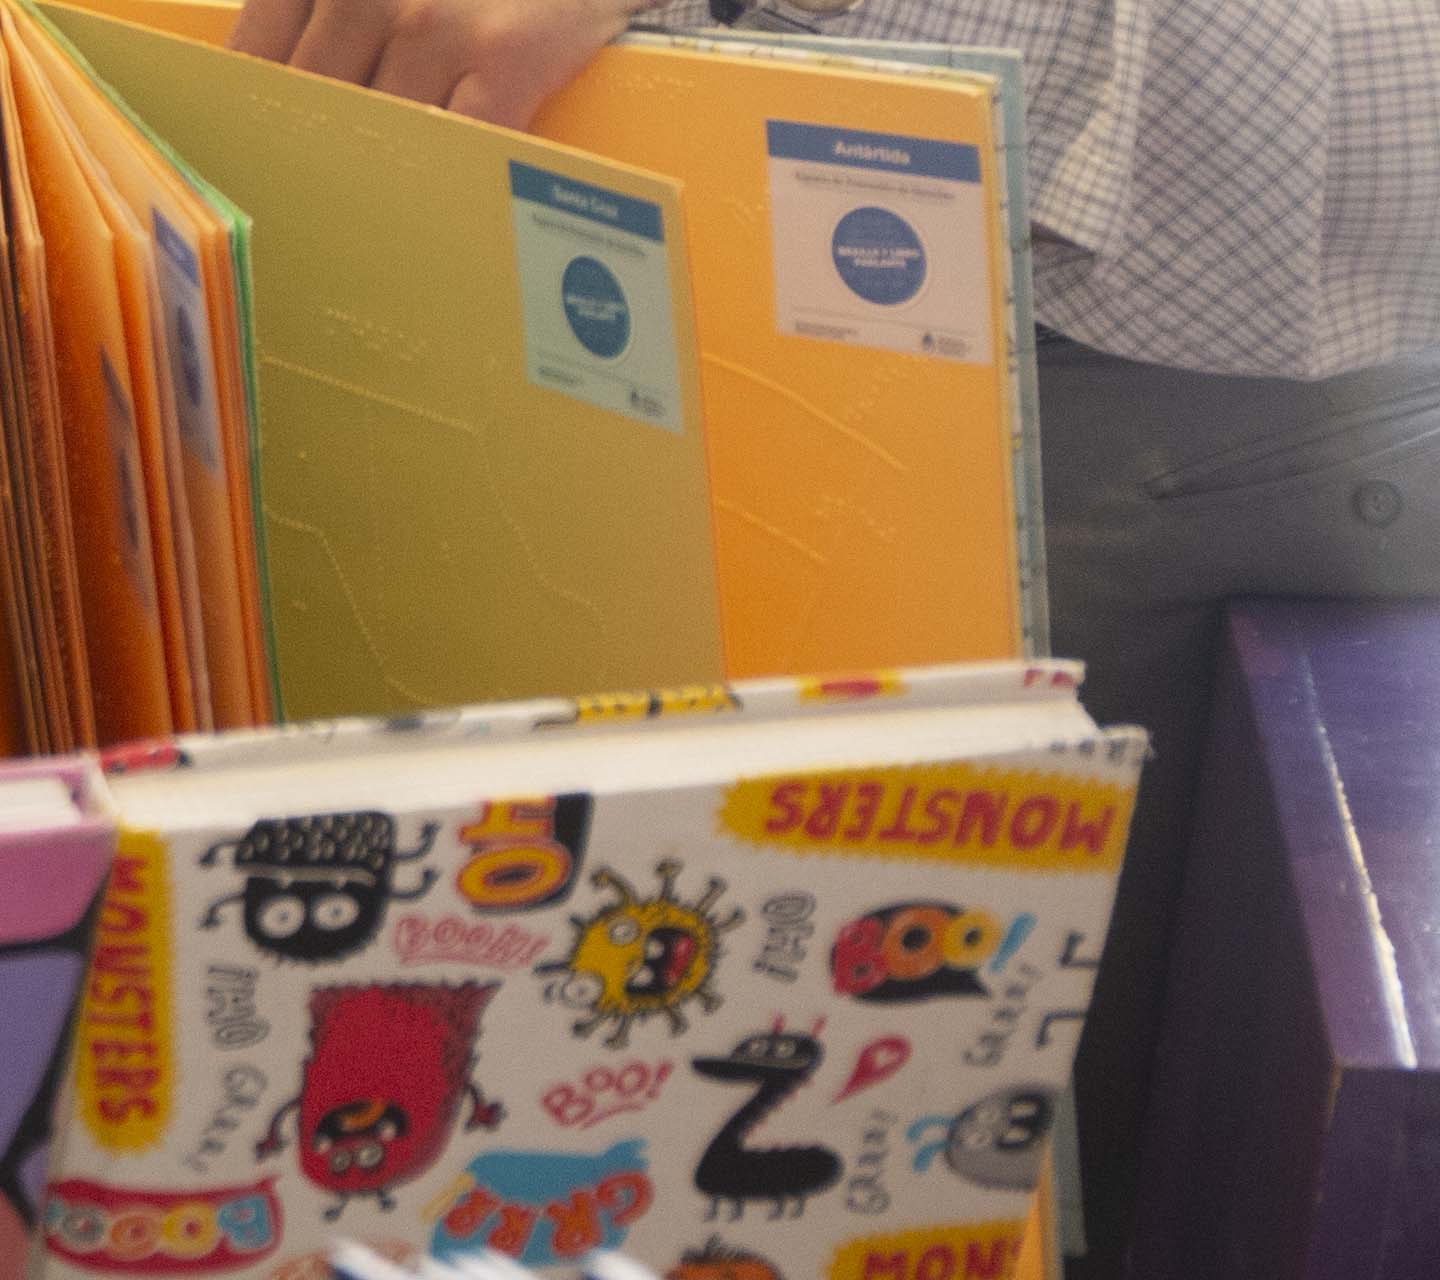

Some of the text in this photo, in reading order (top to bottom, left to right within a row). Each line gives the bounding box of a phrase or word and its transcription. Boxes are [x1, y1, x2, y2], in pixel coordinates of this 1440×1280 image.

[766, 780, 1118, 856] MONSTERS
[87, 856, 160, 1126] MONSTERS
[863, 1237, 1025, 1280] MON
